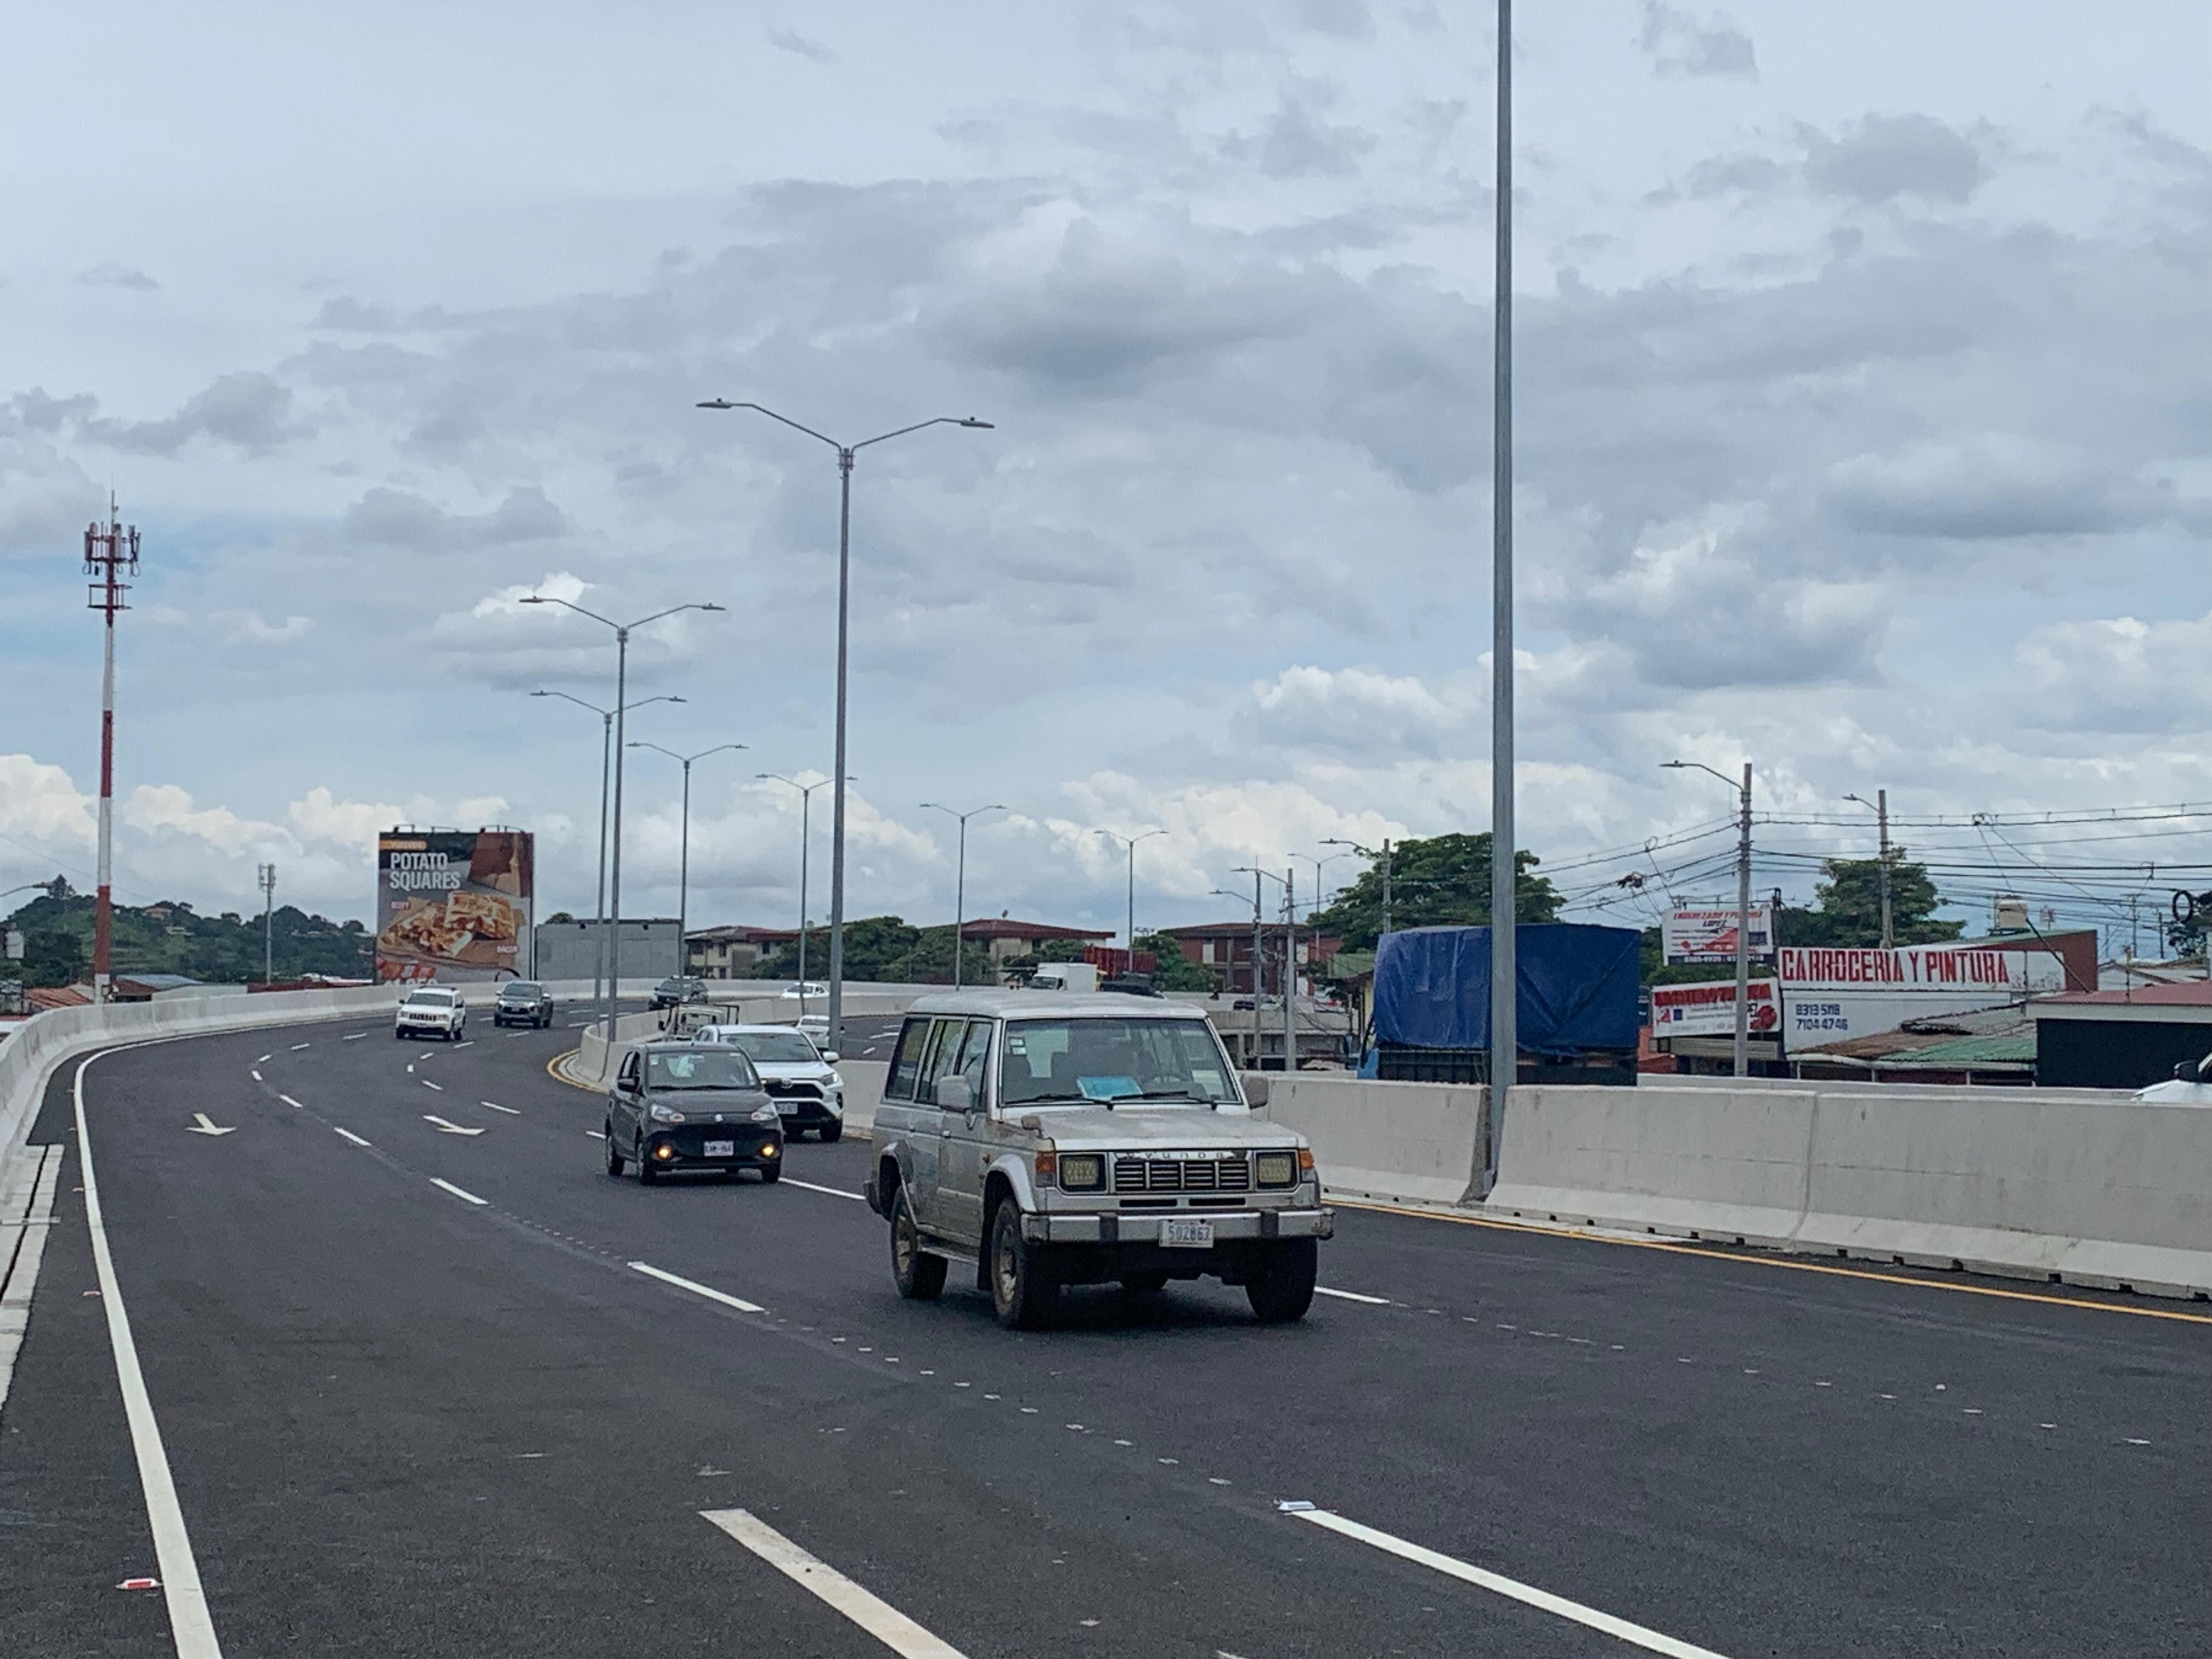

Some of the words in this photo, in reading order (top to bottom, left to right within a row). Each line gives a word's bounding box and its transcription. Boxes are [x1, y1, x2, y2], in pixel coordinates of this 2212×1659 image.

[390, 852, 448, 871] POTATO
[390, 871, 461, 891] SQUARES
[1781, 949, 1904, 982] CARROCERIA
[1909, 950, 1919, 983] Y
[1925, 951, 2010, 984] PINTURA
[1168, 1225, 1210, 1241] 502867
